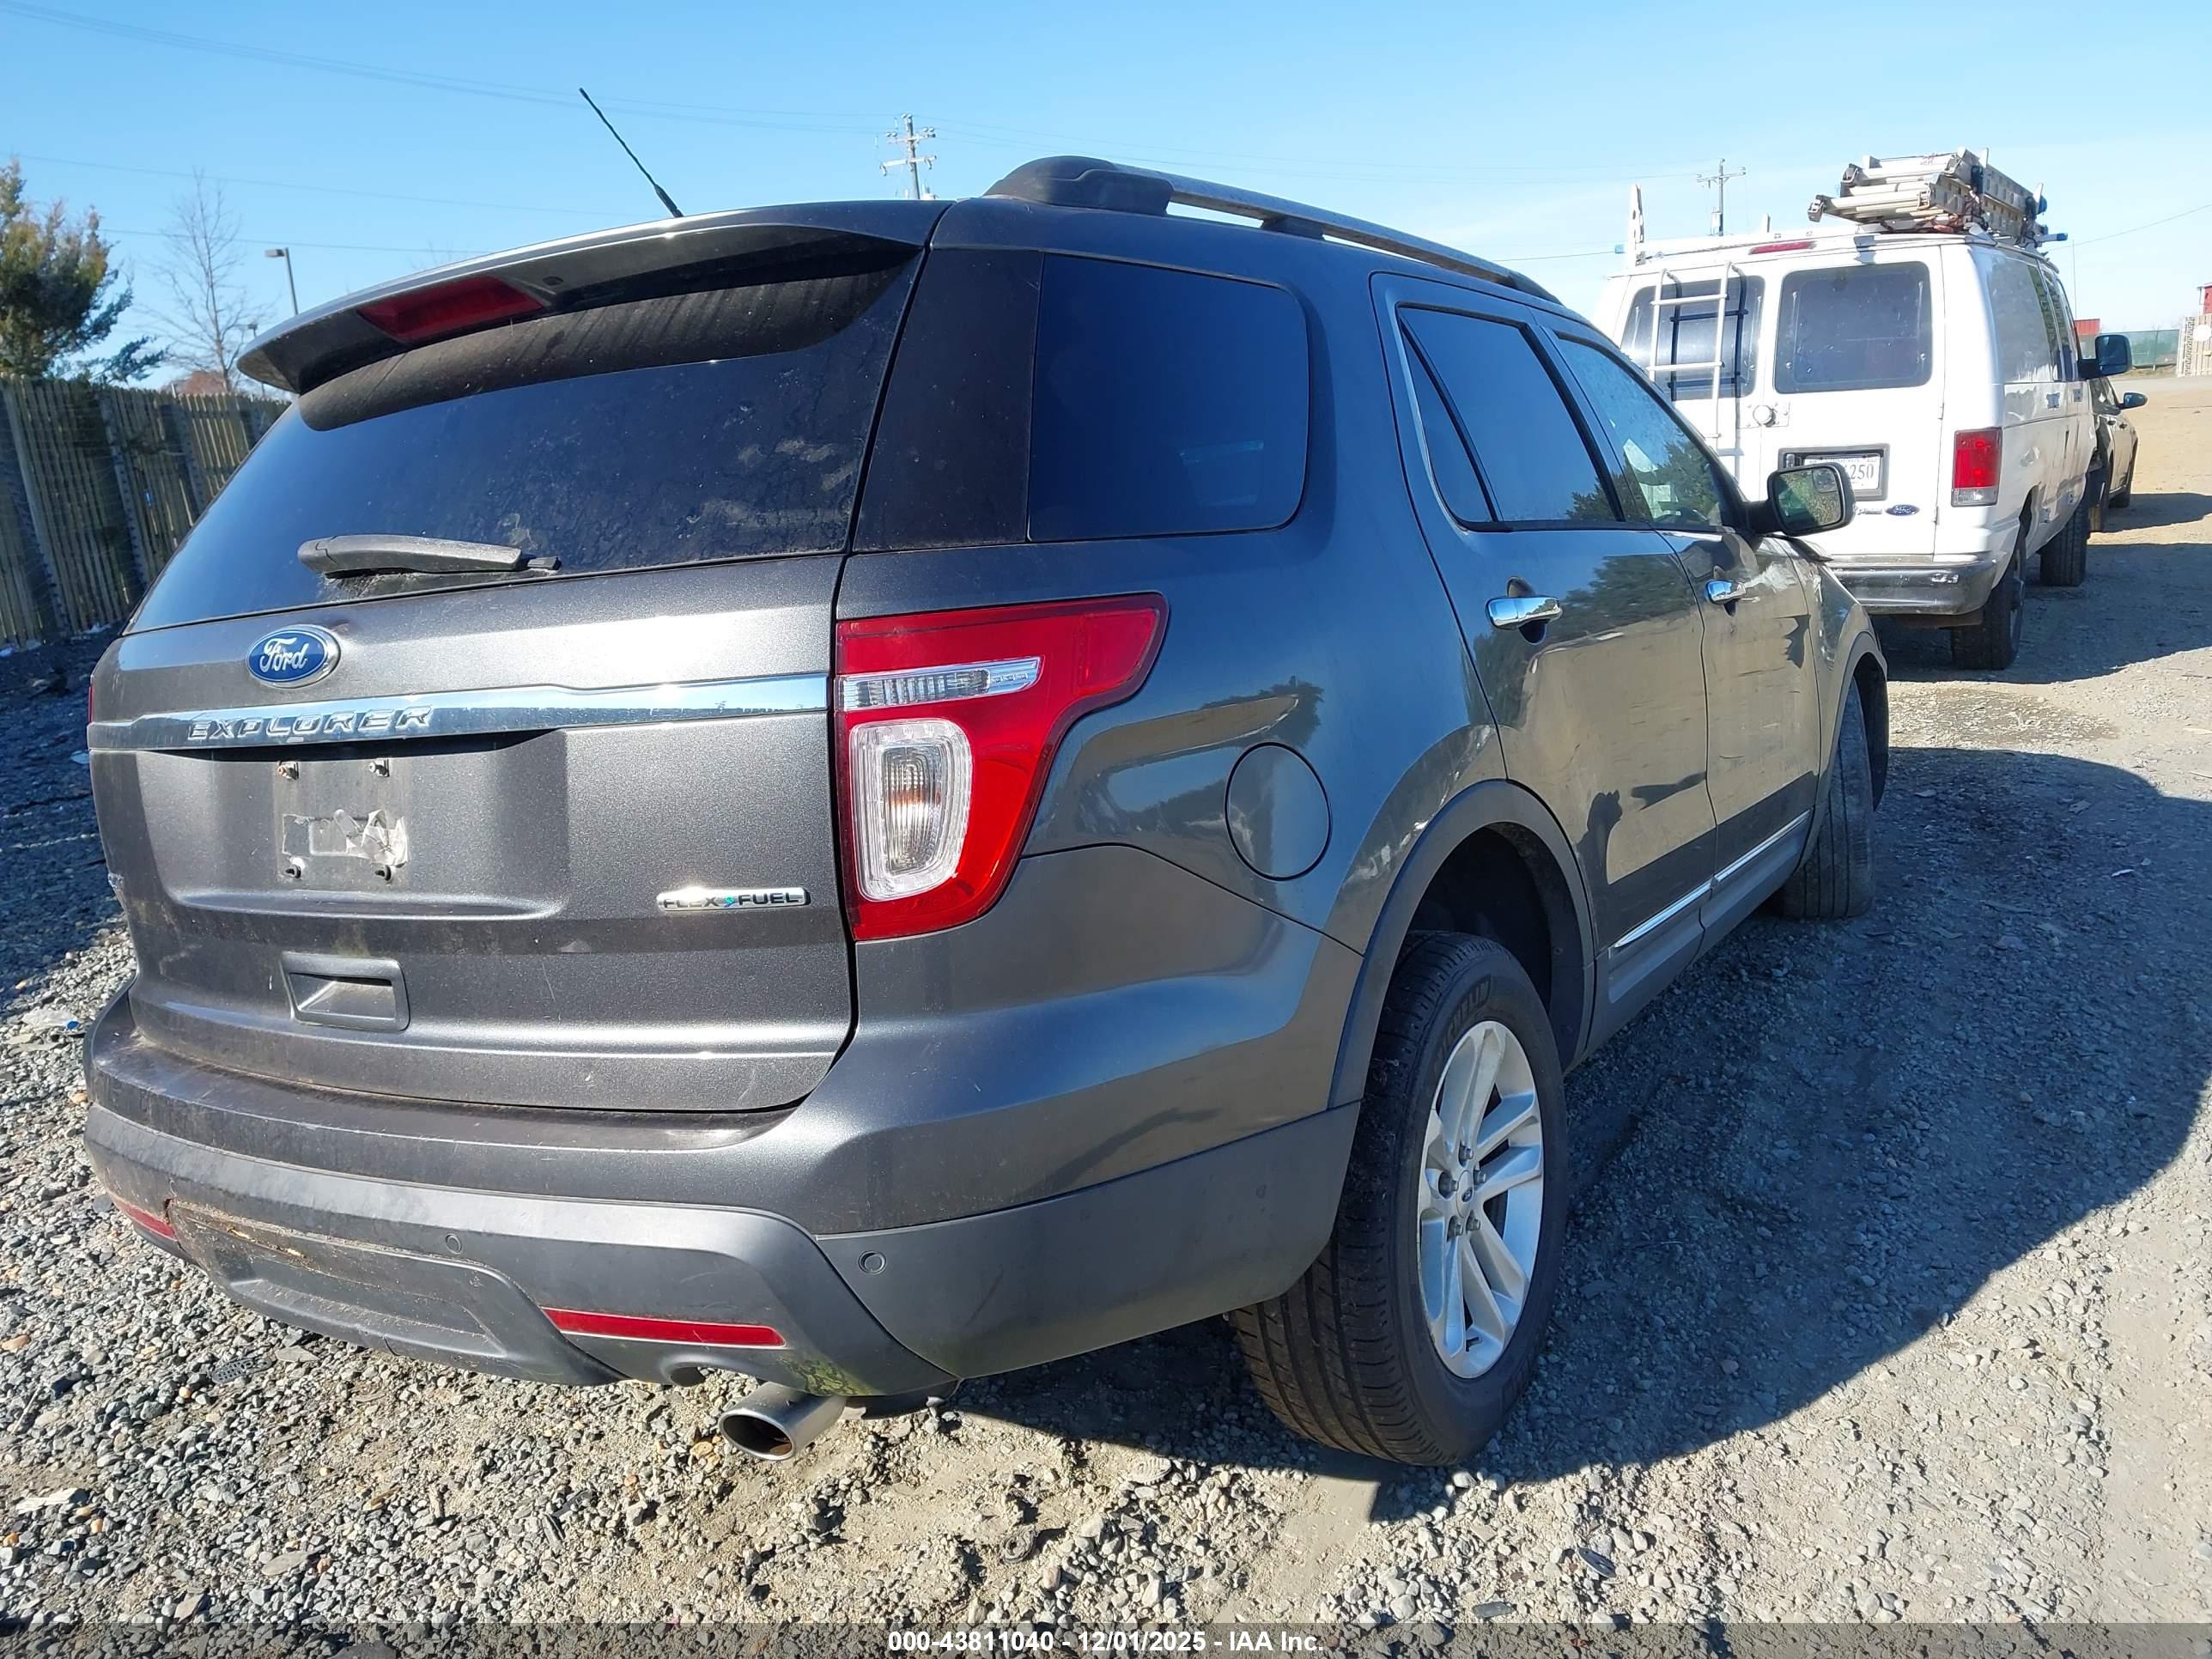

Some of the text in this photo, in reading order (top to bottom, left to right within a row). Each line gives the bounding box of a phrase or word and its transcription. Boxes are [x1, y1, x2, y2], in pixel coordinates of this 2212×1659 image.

[1844, 464, 1874, 480] 250
[259, 637, 309, 672] Ford
[187, 705, 432, 740] EXPLORER
[738, 891, 804, 906] FUEL
